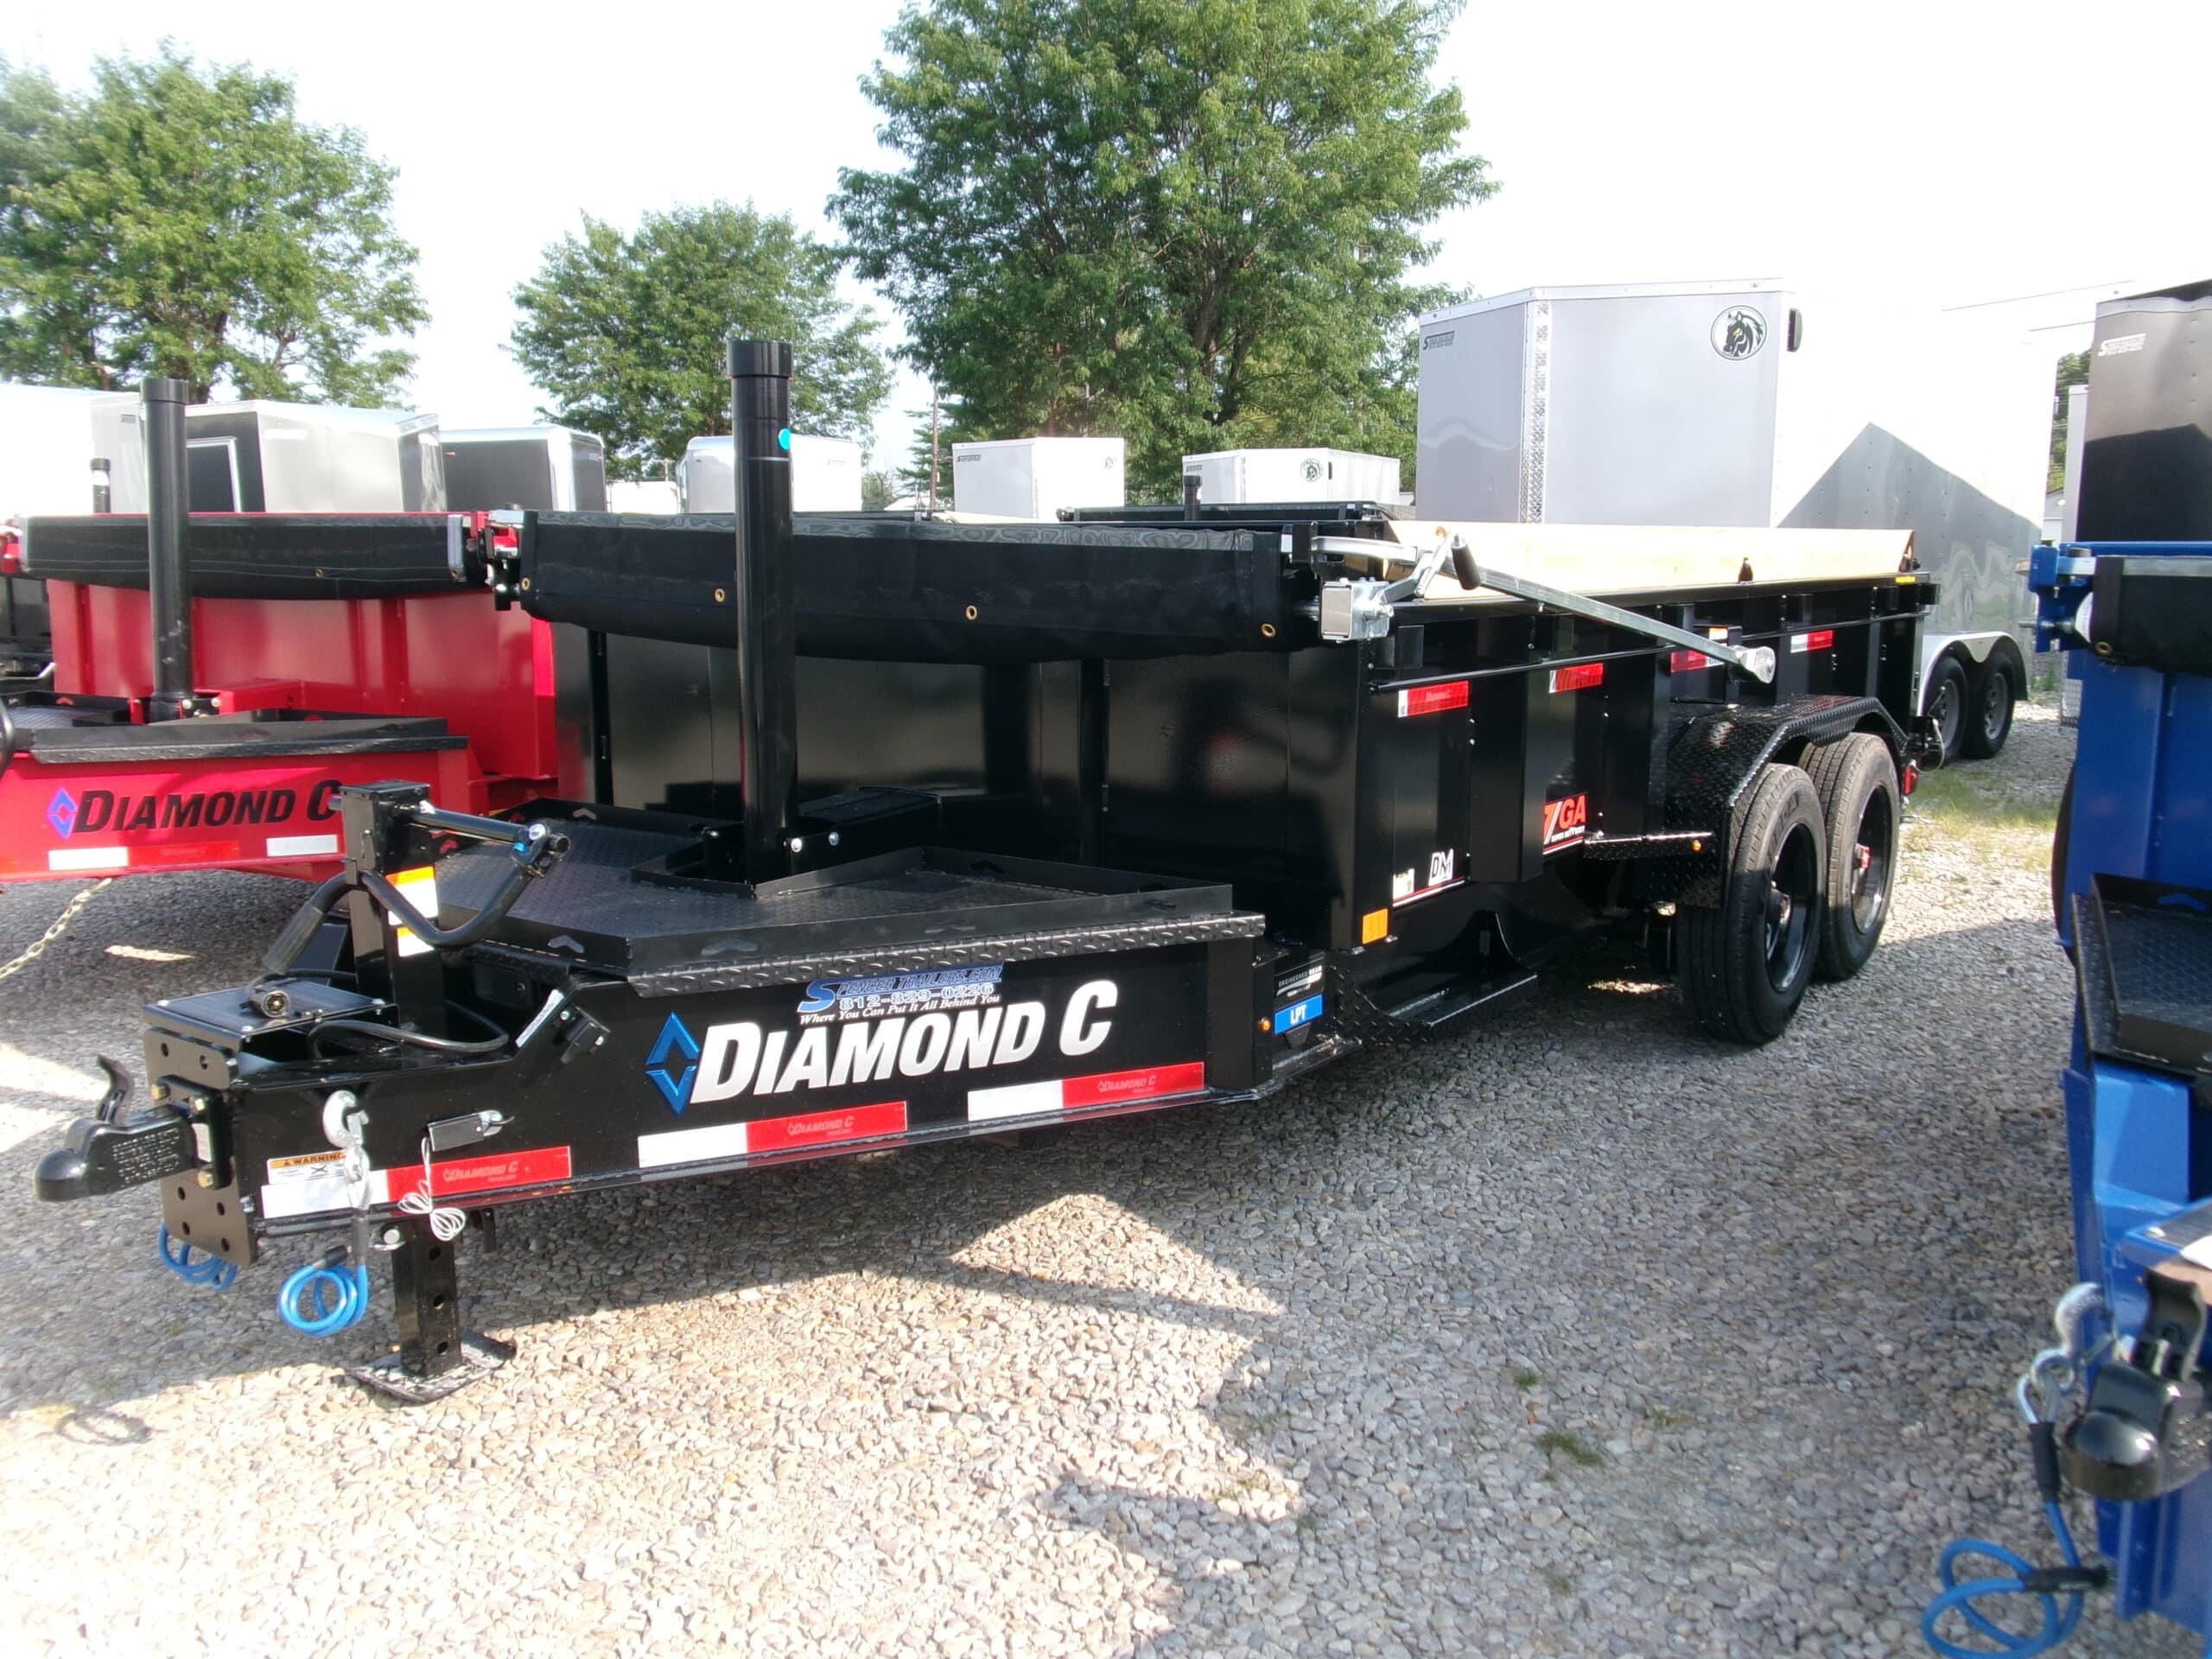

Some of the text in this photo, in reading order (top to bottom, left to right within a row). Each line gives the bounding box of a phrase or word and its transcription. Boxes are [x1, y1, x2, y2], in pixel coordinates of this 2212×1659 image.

[73, 779, 342, 833] DIAMOND C
[800, 994, 1000, 1026] Where You Can Put It All Behind You
[839, 982, 995, 1011] 812-829-0226
[1290, 1004, 1307, 1026] LPT
[690, 980, 1118, 1104] DIAMOND C
